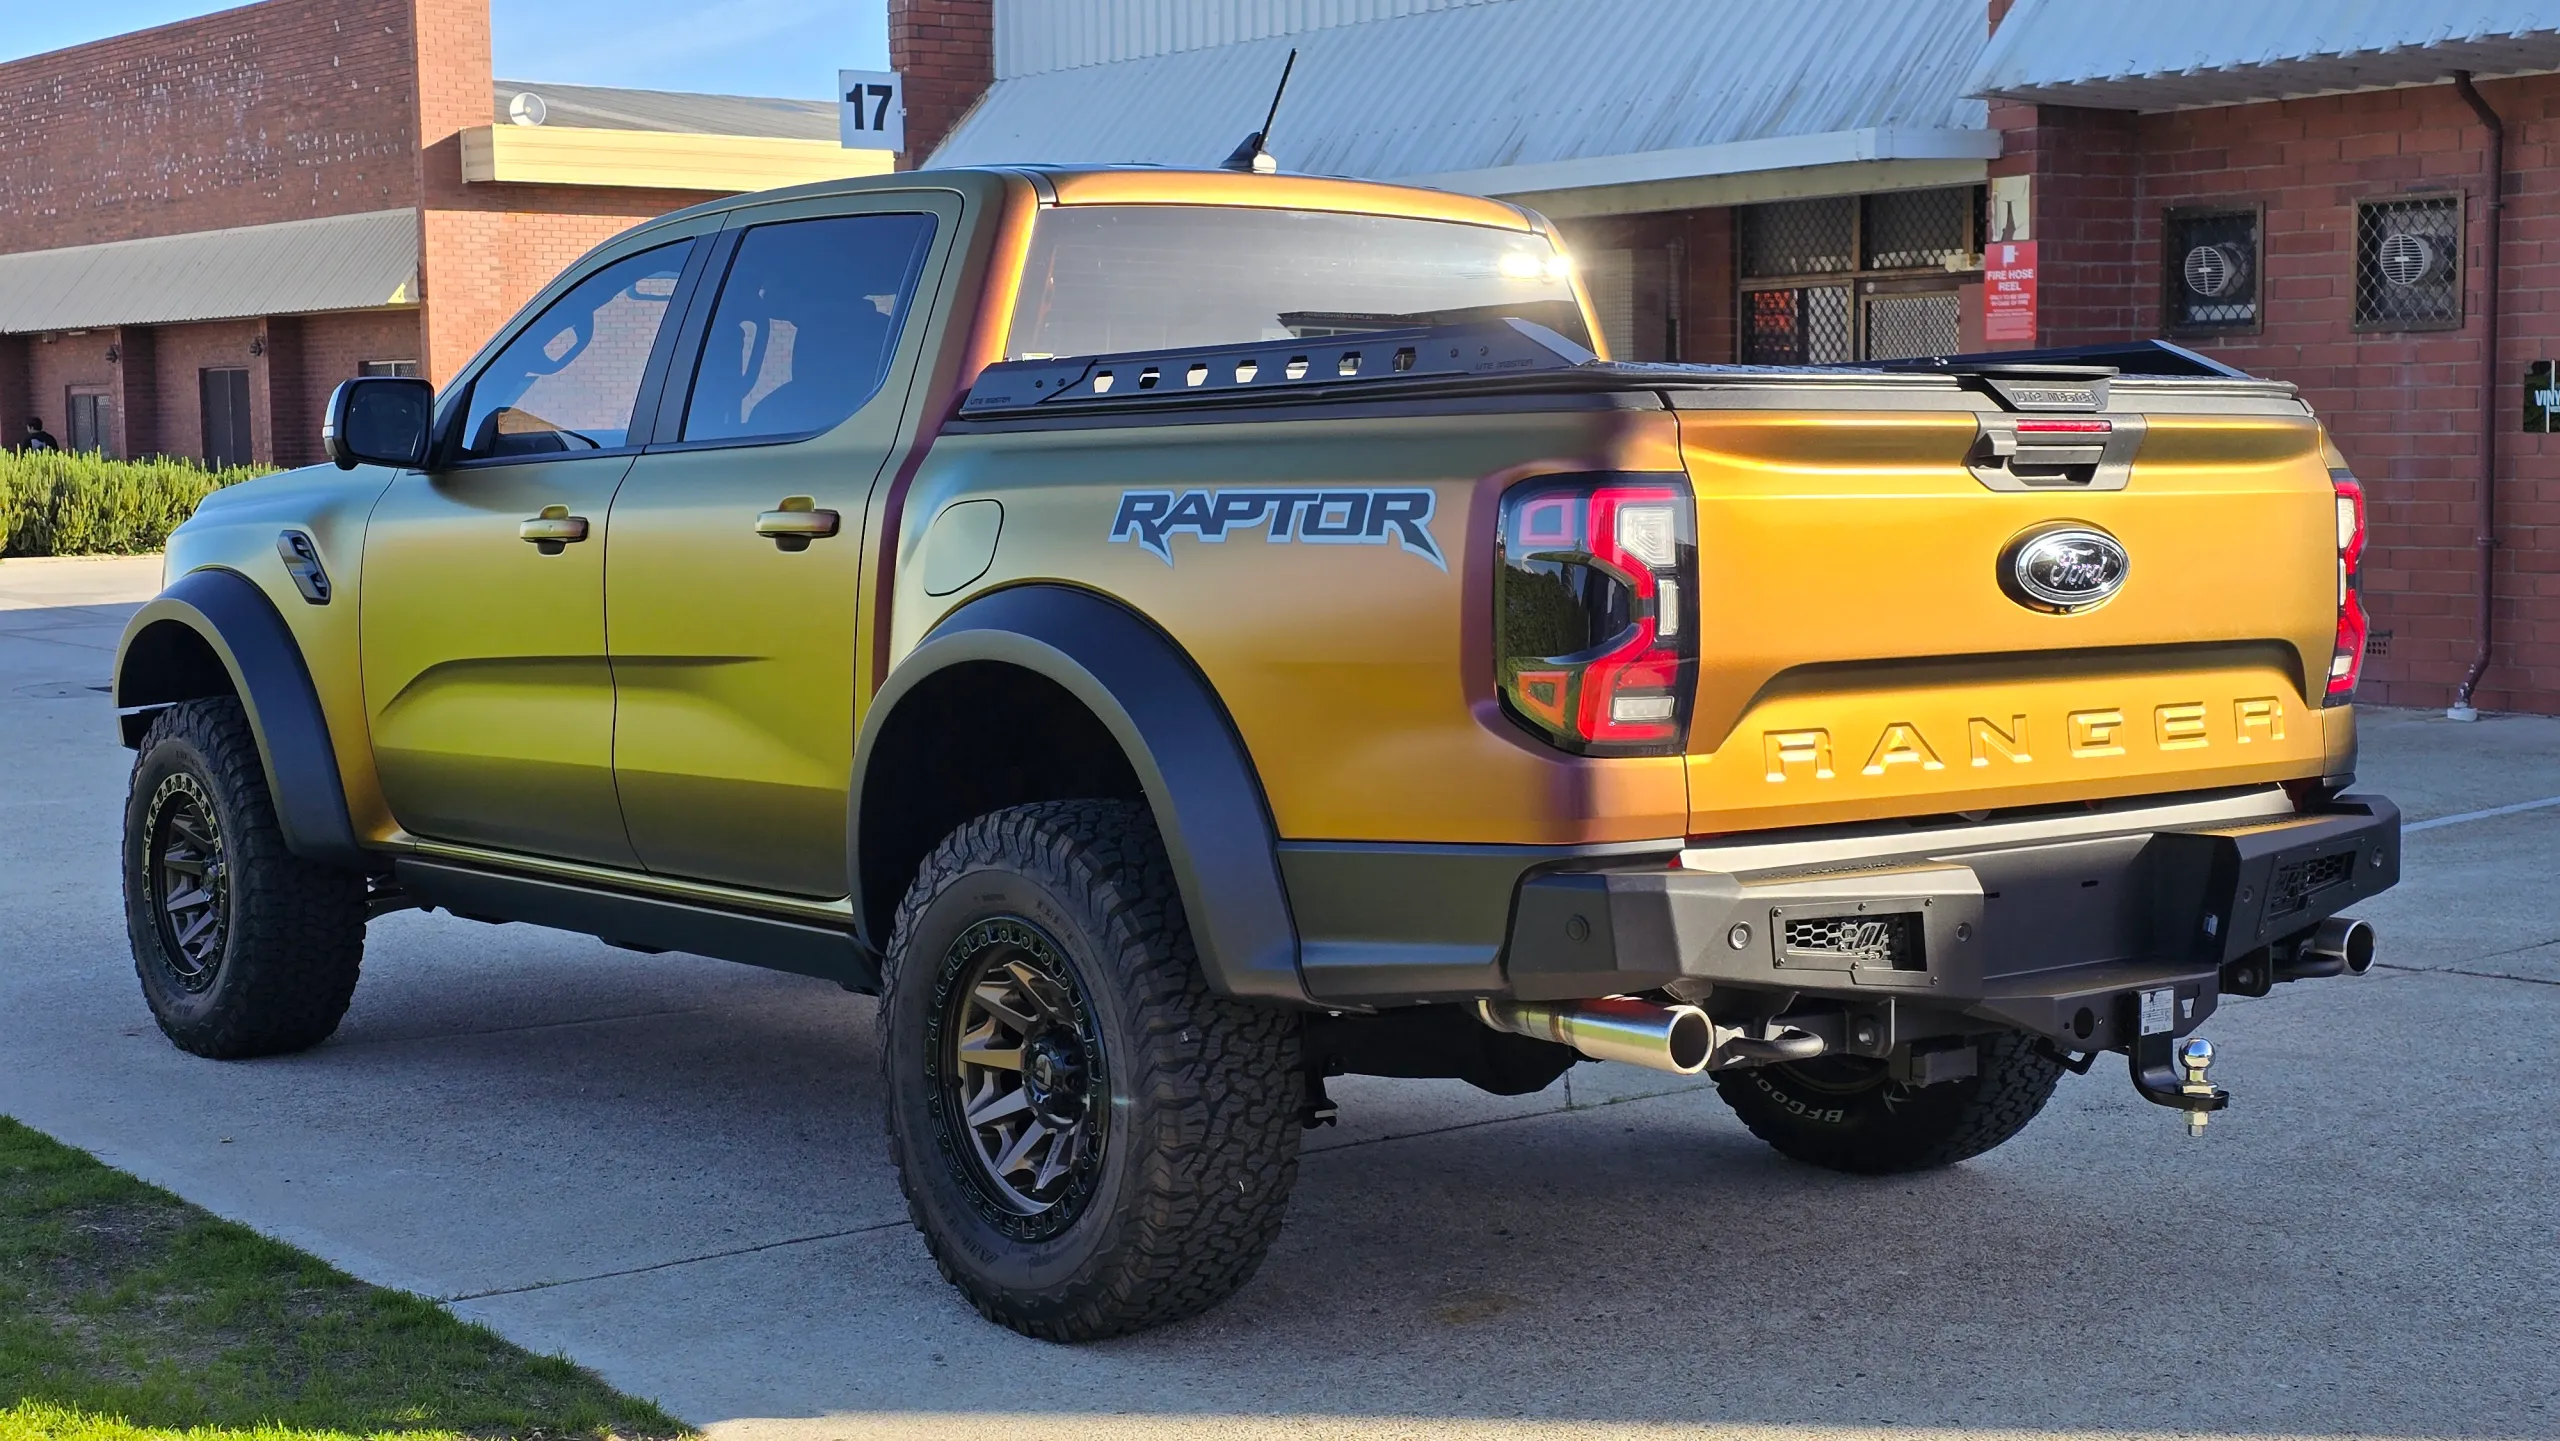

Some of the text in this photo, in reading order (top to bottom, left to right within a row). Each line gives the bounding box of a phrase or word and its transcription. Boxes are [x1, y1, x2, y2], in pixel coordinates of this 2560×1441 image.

[846, 83, 893, 131] 17
[1987, 269, 2034, 280] FIRE HOSE
[1998, 281, 2022, 291] REEL
[1108, 489, 1448, 572] RAPTOR
[2040, 544, 2108, 586] Ford
[1763, 695, 2286, 782] RANGER
